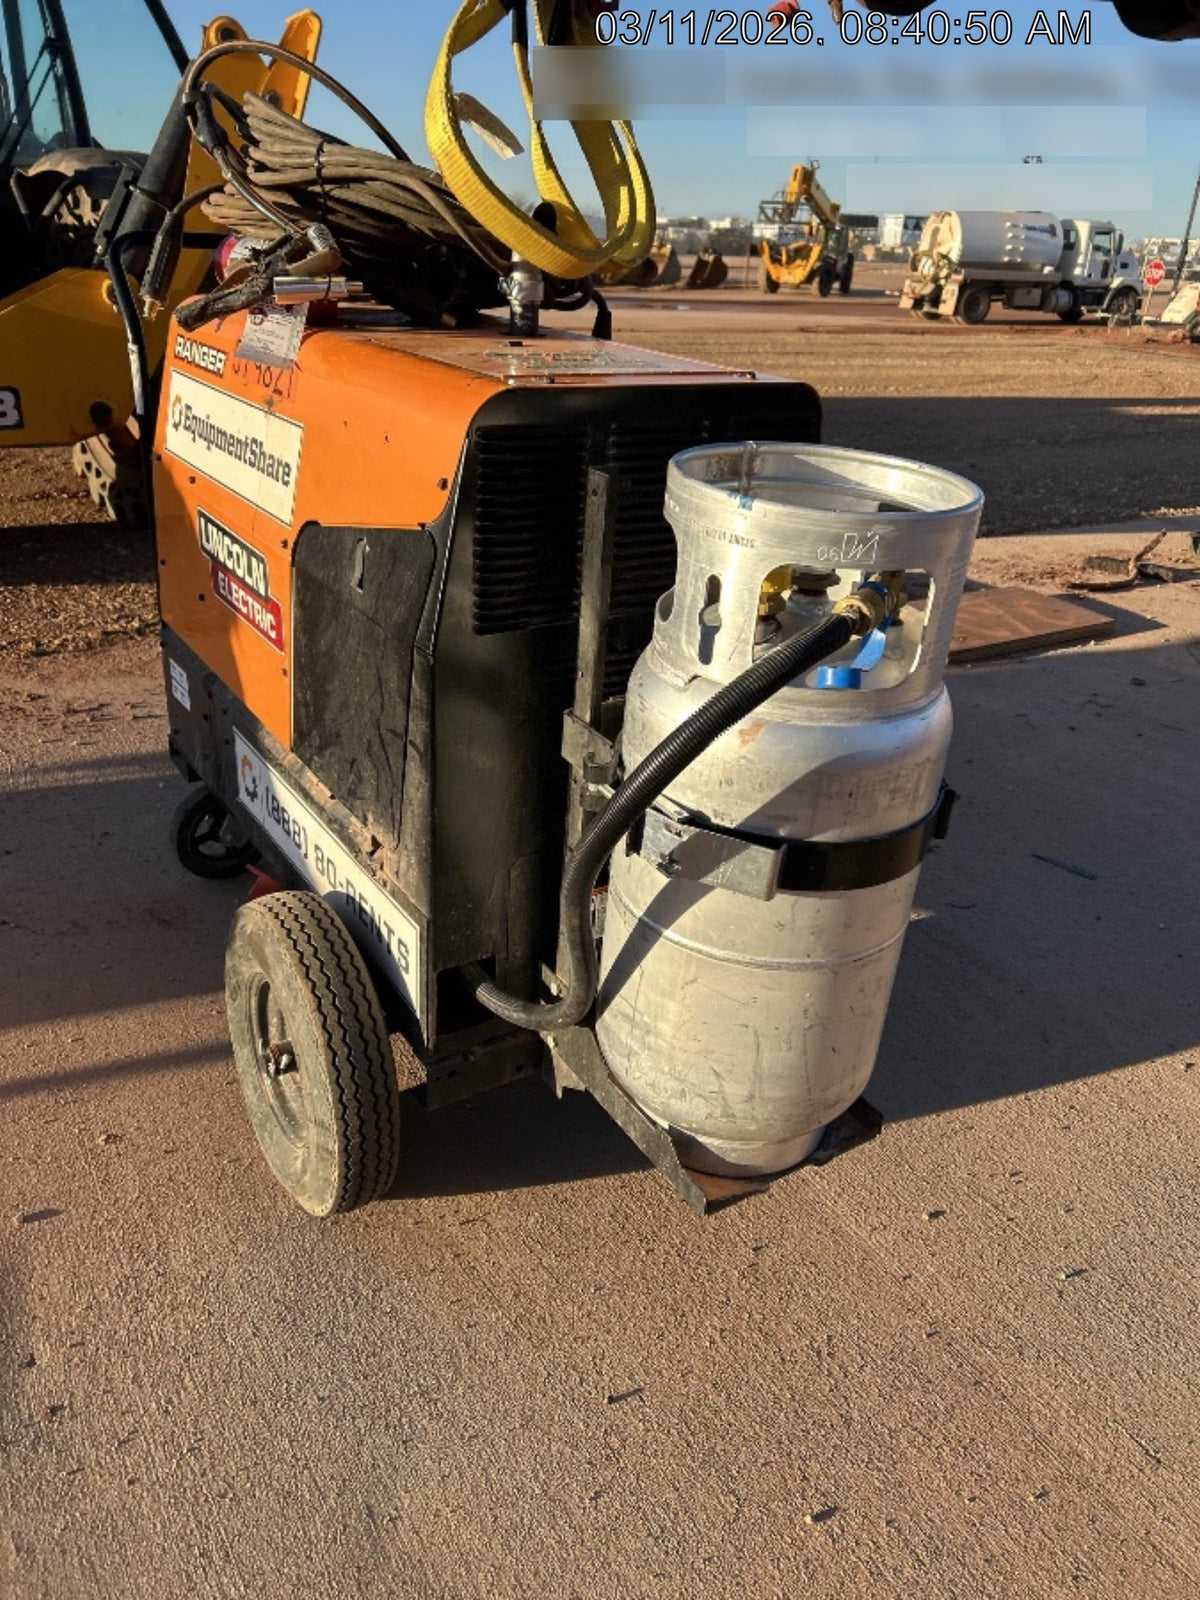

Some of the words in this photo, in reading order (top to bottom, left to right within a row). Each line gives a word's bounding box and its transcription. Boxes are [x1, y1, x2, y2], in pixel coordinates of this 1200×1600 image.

[174, 336, 227, 375] RANGER
[182, 403, 293, 488] EquipmentShare
[199, 518, 267, 597] LINCOLN
[217, 570, 278, 640] ELECTRIC
[265, 787, 309, 860] (888)
[313, 844, 410, 976] 80-RENTS
